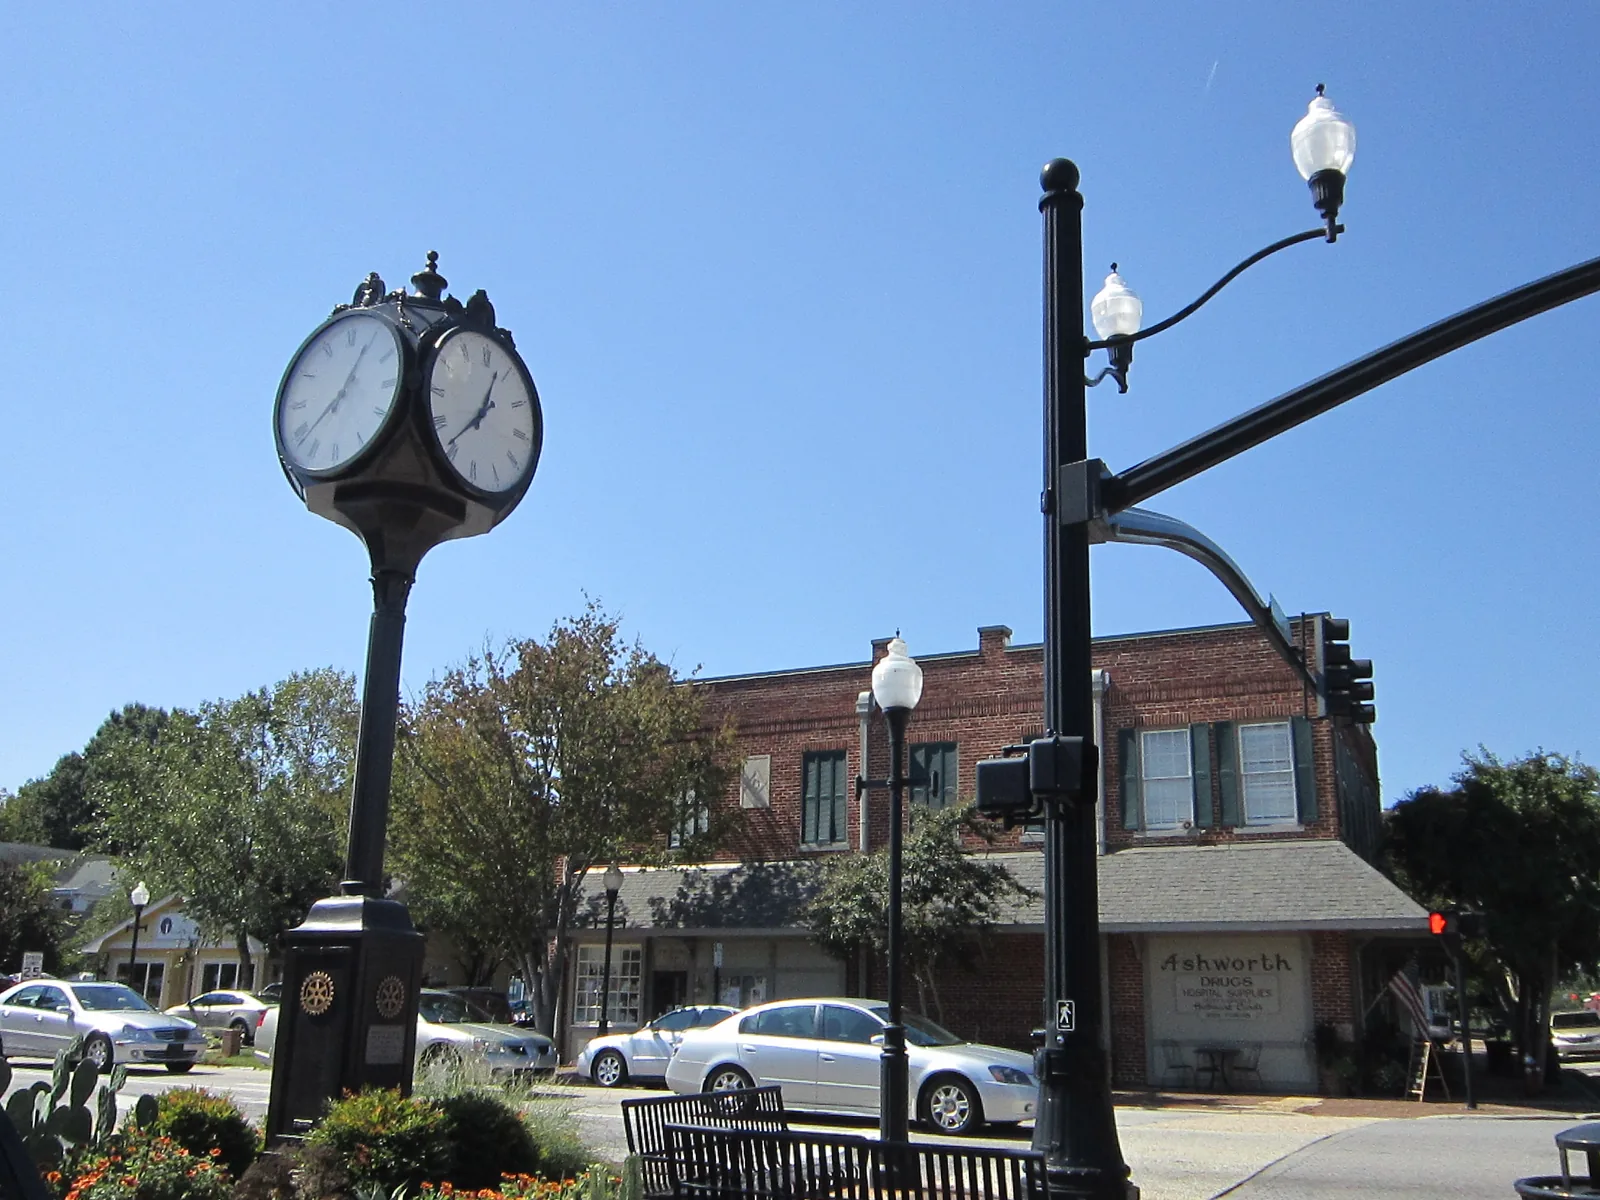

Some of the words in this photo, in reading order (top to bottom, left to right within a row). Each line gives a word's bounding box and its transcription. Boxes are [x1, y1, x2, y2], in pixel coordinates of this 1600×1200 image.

[1160, 953, 1292, 972] Ashworth
[24, 966, 40, 978] 25
[1200, 976, 1253, 987] DRUGS
